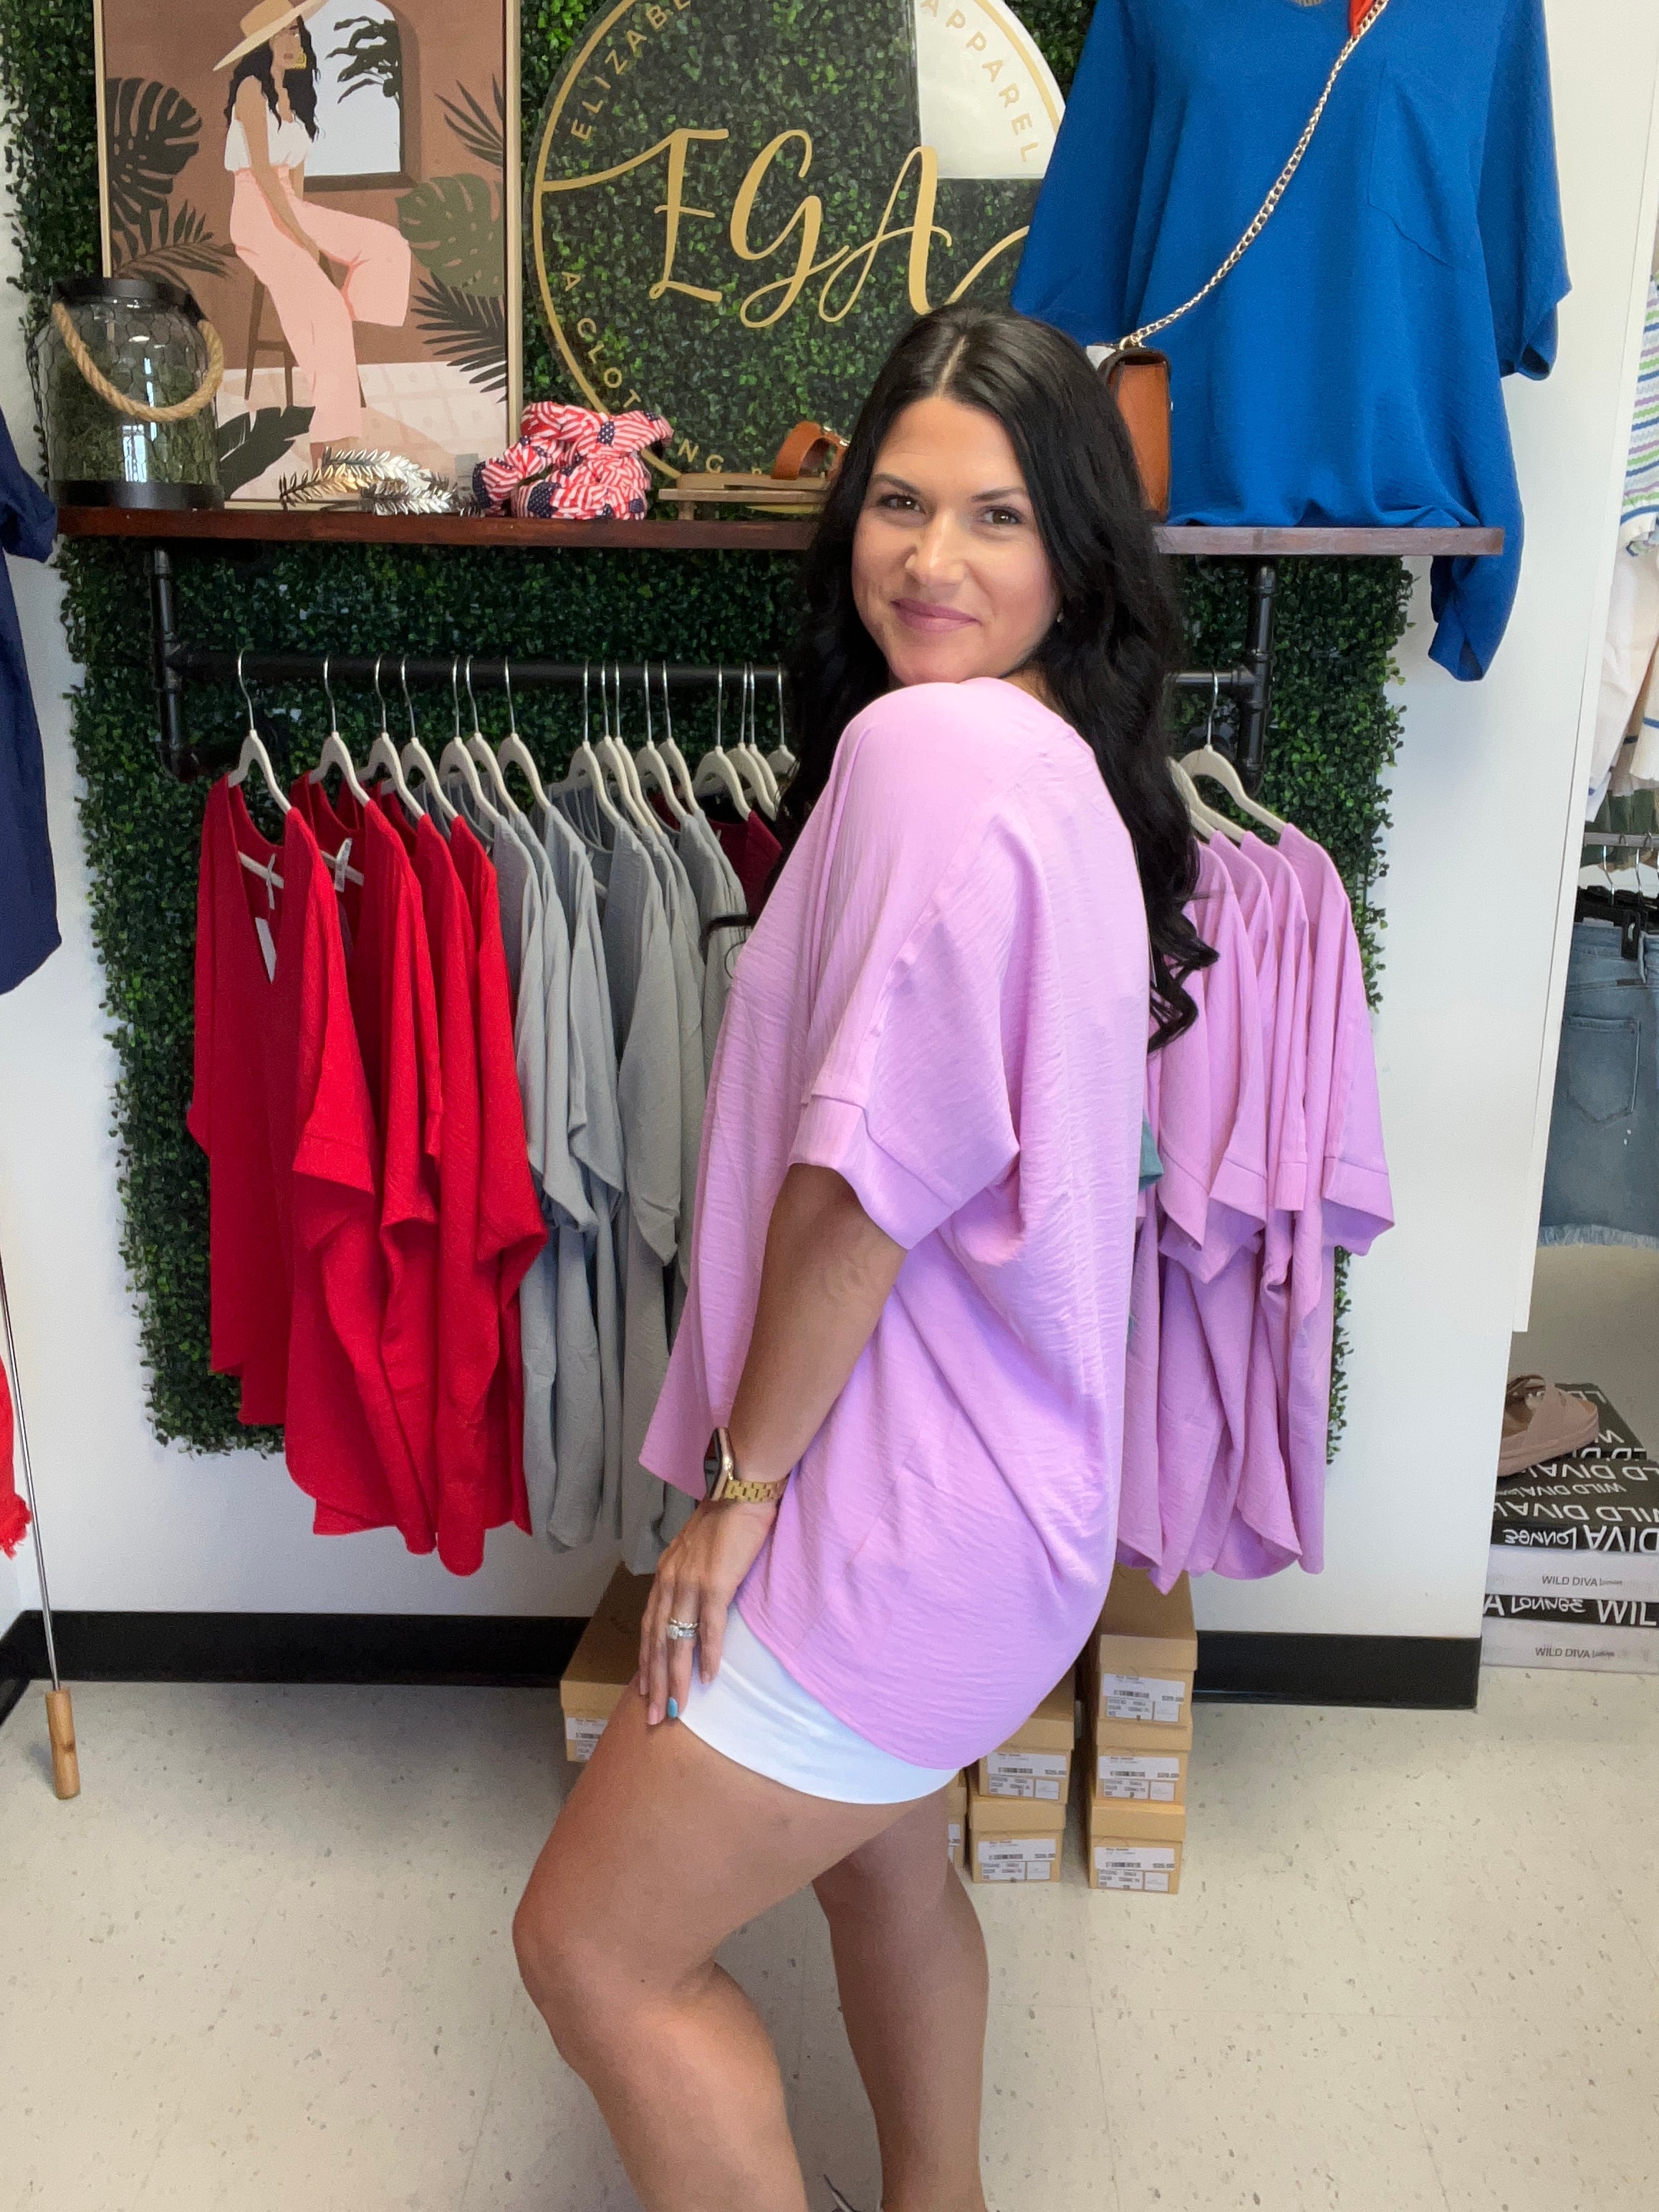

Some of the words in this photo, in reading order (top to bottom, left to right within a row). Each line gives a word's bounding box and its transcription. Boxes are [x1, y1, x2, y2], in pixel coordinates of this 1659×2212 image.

[562, 271, 582, 292] A
[577, 317, 724, 473] CLOTNG
[1572, 1482, 1627, 1494] WILD
[1505, 1501, 1590, 1520] DIVA
[1583, 1524, 1659, 1553] DIVA
[1542, 1575, 1570, 1585] WILD
[1572, 1577, 1598, 1587] DIVA
[1535, 1647, 1563, 1657] WILD
[1565, 1648, 1590, 1658] DIVA
